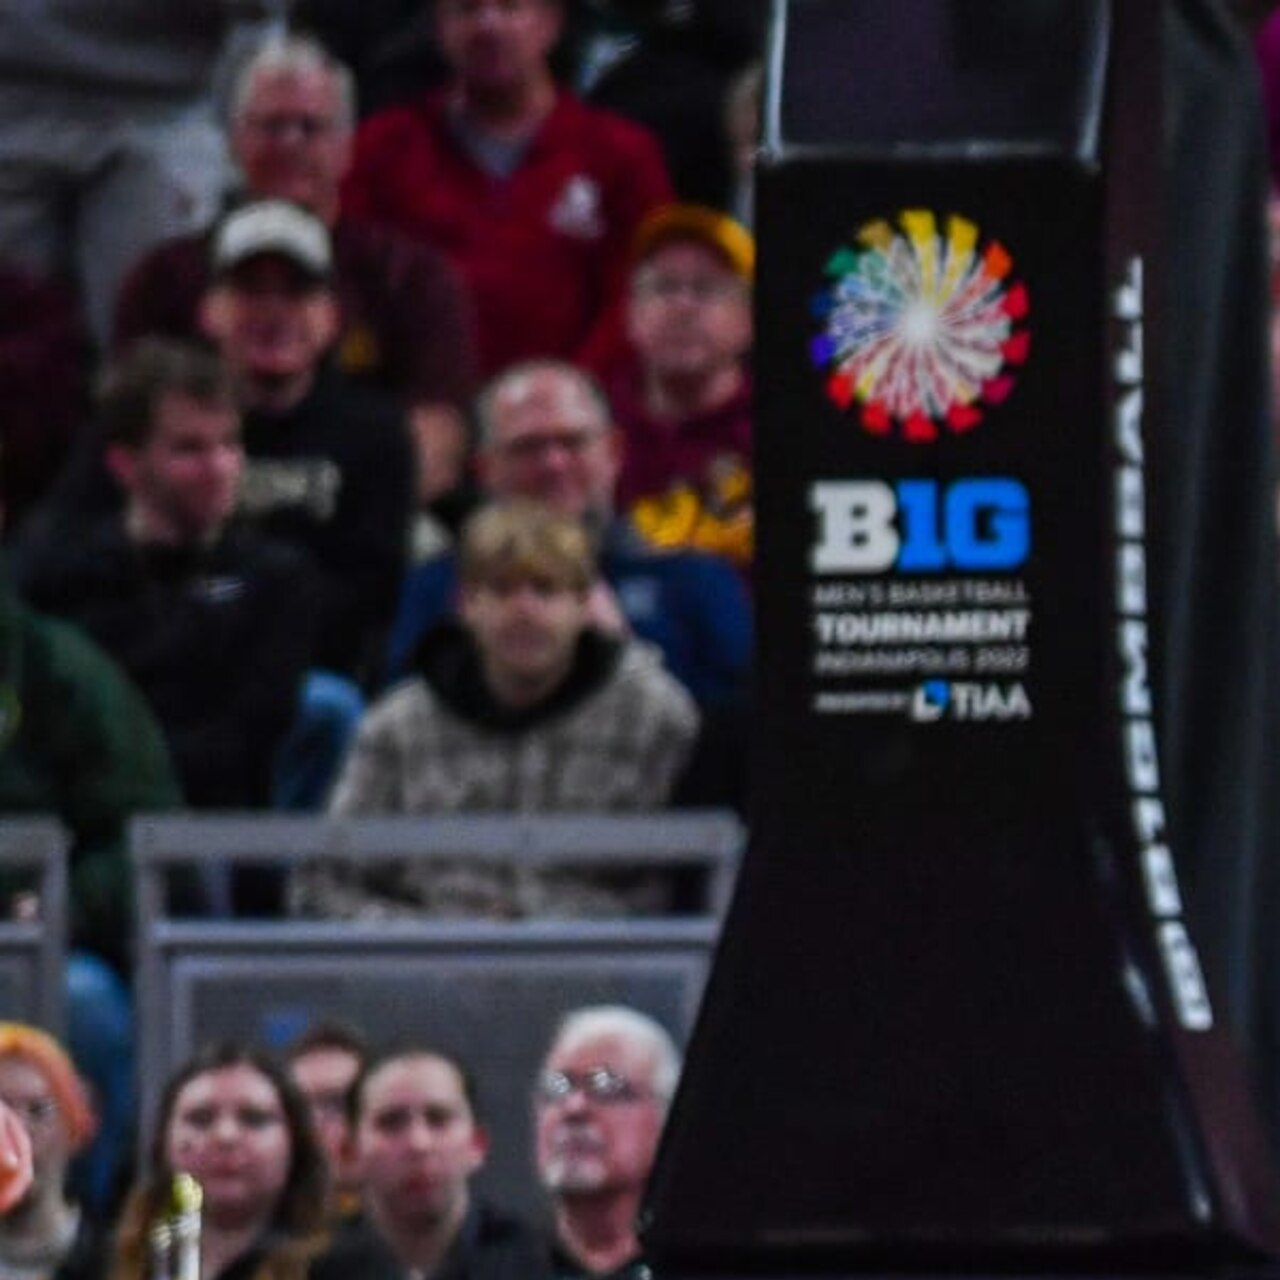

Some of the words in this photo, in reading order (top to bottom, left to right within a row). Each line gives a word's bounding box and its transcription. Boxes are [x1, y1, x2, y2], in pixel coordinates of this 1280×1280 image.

[888, 578, 1028, 603] BASKETBALL
[815, 608, 1032, 645] TOURNAMENT
[952, 682, 1032, 721] TIAA
